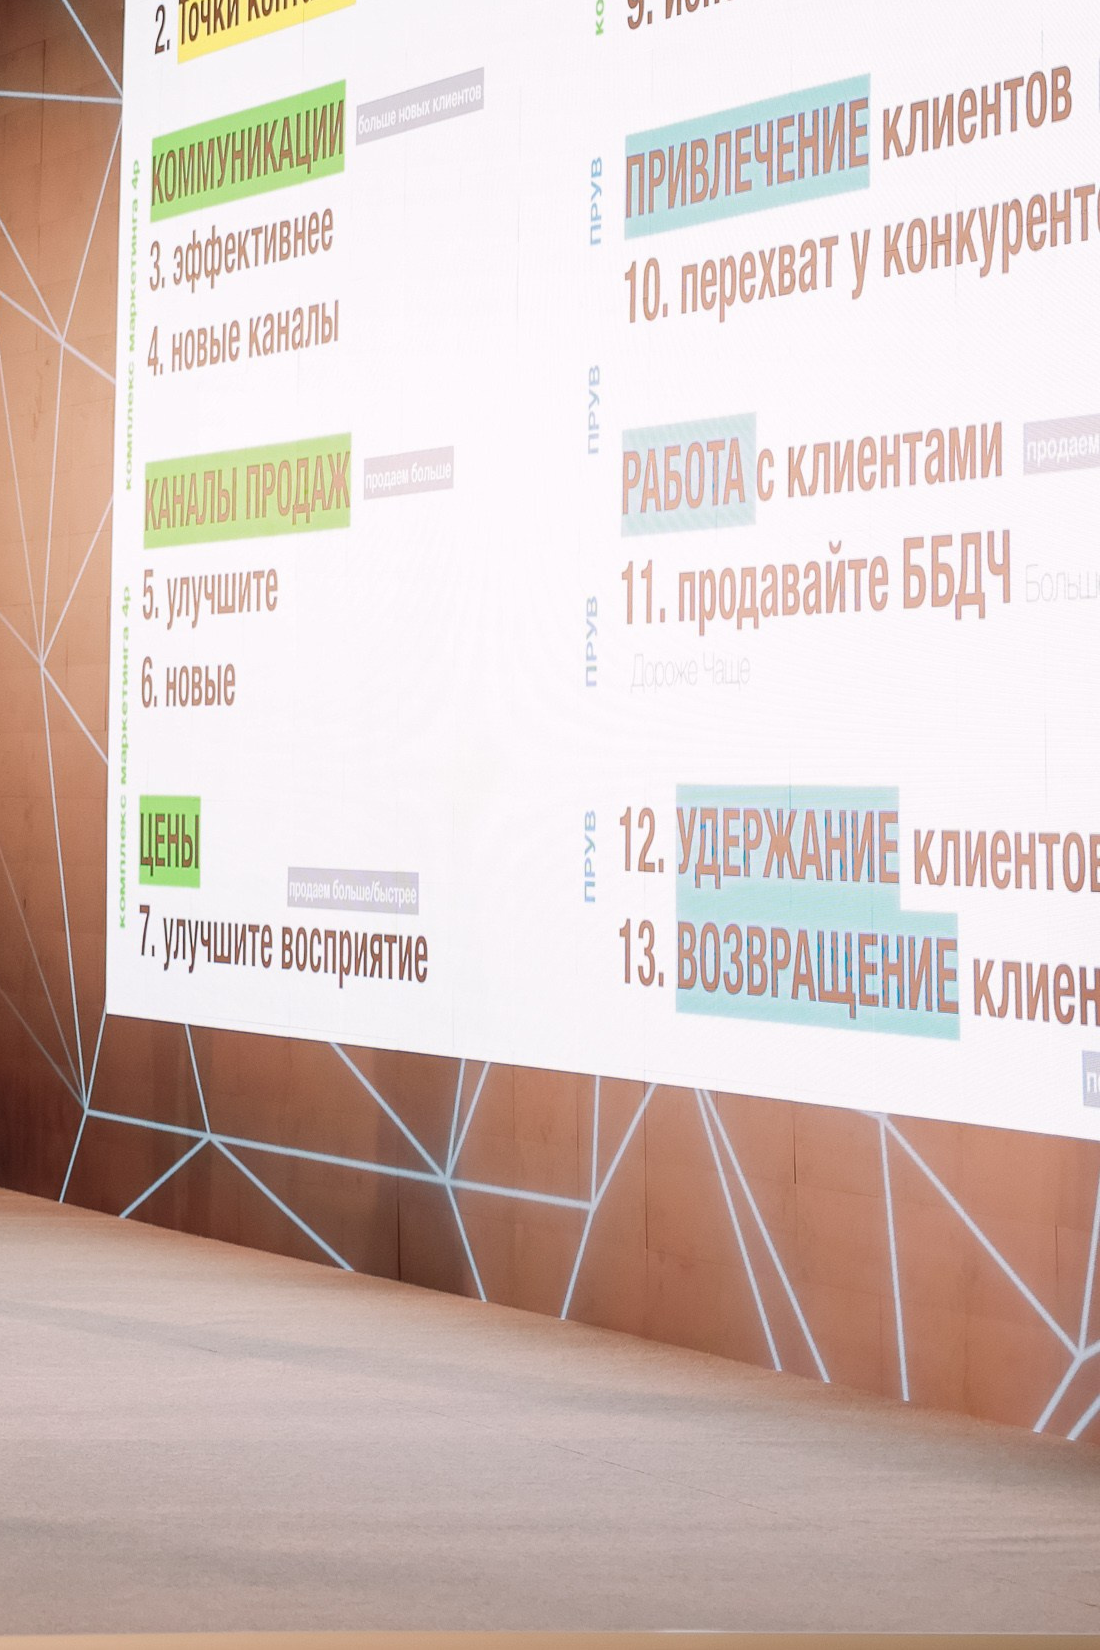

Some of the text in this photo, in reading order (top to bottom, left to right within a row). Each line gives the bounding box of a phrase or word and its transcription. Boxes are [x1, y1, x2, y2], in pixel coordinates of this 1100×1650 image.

[154, 3, 171, 54] 2.
[151, 99, 345, 206] КОММУНИКАЦИИ
[358, 84, 482, 135] больше новых клиентов
[626, 65, 1072, 219] ПРИВЛЕЧЕНИЕ клиентов
[590, 157, 602, 245] ПРУВ
[128, 198, 139, 353] маркетинга
[150, 207, 334, 293] 3. эффективнее
[625, 183, 1100, 324] 10. перехват у конкурент
[147, 299, 339, 377] 4. новые каналы
[125, 361, 135, 491] комплекс
[588, 365, 600, 455] ПРУВ
[1026, 433, 1100, 467] продаем
[145, 451, 351, 531] КАНАЛЫ ПРОДАЖ
[365, 461, 452, 493] продаем больше
[622, 420, 1002, 516] РАБОТА с клиентами
[143, 567, 278, 630] 5. улучшите
[622, 530, 1100, 636] 11. продавайте ББДЧ Больш
[141, 656, 236, 708] 6. новые
[585, 595, 598, 687] ПРУВ
[630, 650, 751, 693] Дороже Чаще
[121, 626, 130, 785] маркетинга
[119, 795, 128, 929] комплекс
[139, 812, 200, 877] ЦЕНЫ
[584, 810, 597, 903] ПРУВ
[620, 807, 664, 873] 12.
[677, 808, 899, 889] УДЕРЖАНИЕ
[289, 879, 418, 909] продаем больше/быстрее
[139, 905, 429, 989] 7. улучшите восприятие
[619, 919, 664, 988] 13.
[677, 921, 959, 1020] ВОЗВРАЩЕНИЕ
